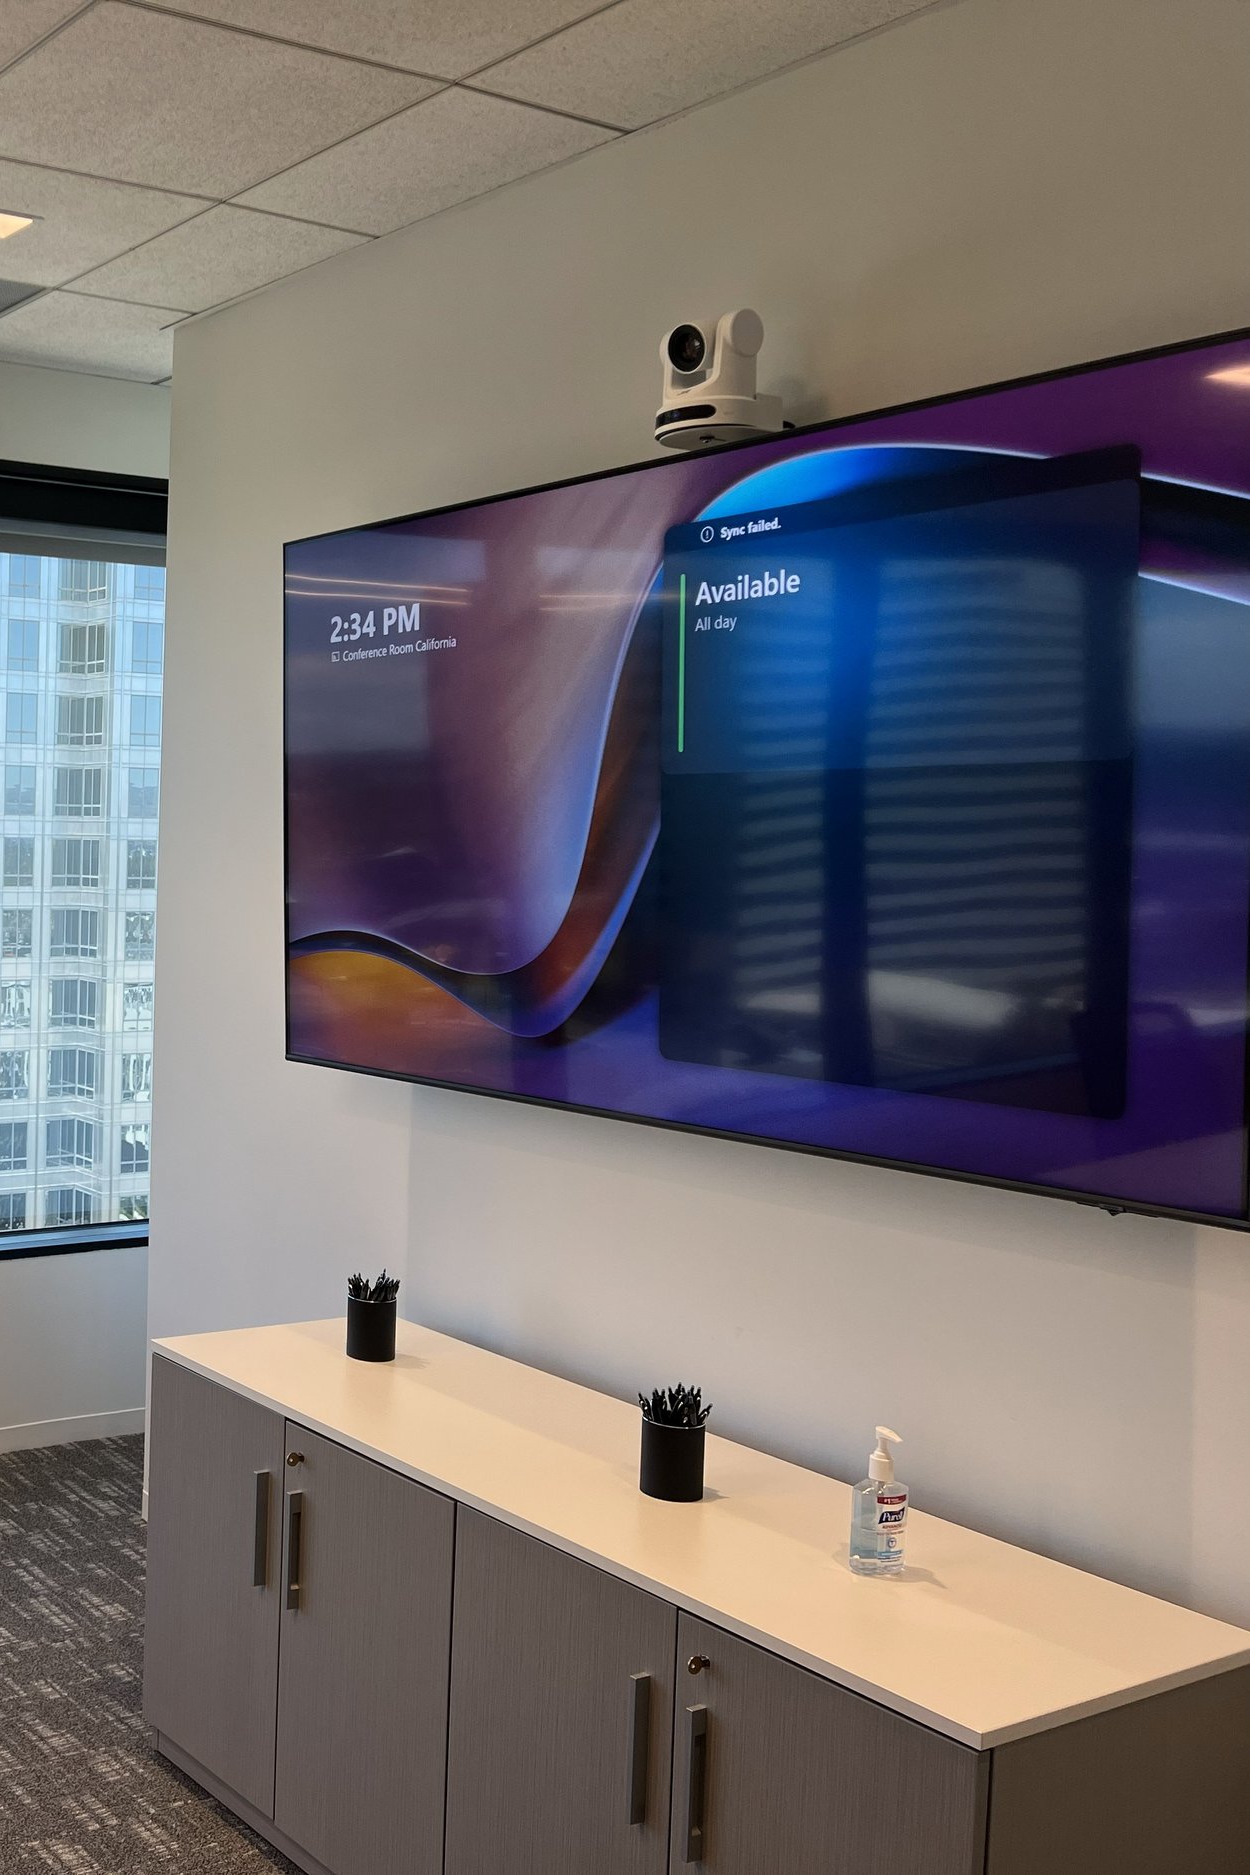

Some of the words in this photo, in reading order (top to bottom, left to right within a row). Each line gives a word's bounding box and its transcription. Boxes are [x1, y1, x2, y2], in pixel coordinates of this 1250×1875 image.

[720, 526, 745, 541] Sync
[747, 517, 782, 534] failed.
[695, 569, 801, 606] Available
[330, 610, 376, 643] 2:34
[383, 603, 420, 636] PM
[695, 616, 711, 632] All
[714, 615, 738, 632] day
[342, 646, 387, 662] Conference
[389, 643, 414, 656] Room
[415, 636, 457, 652] California
